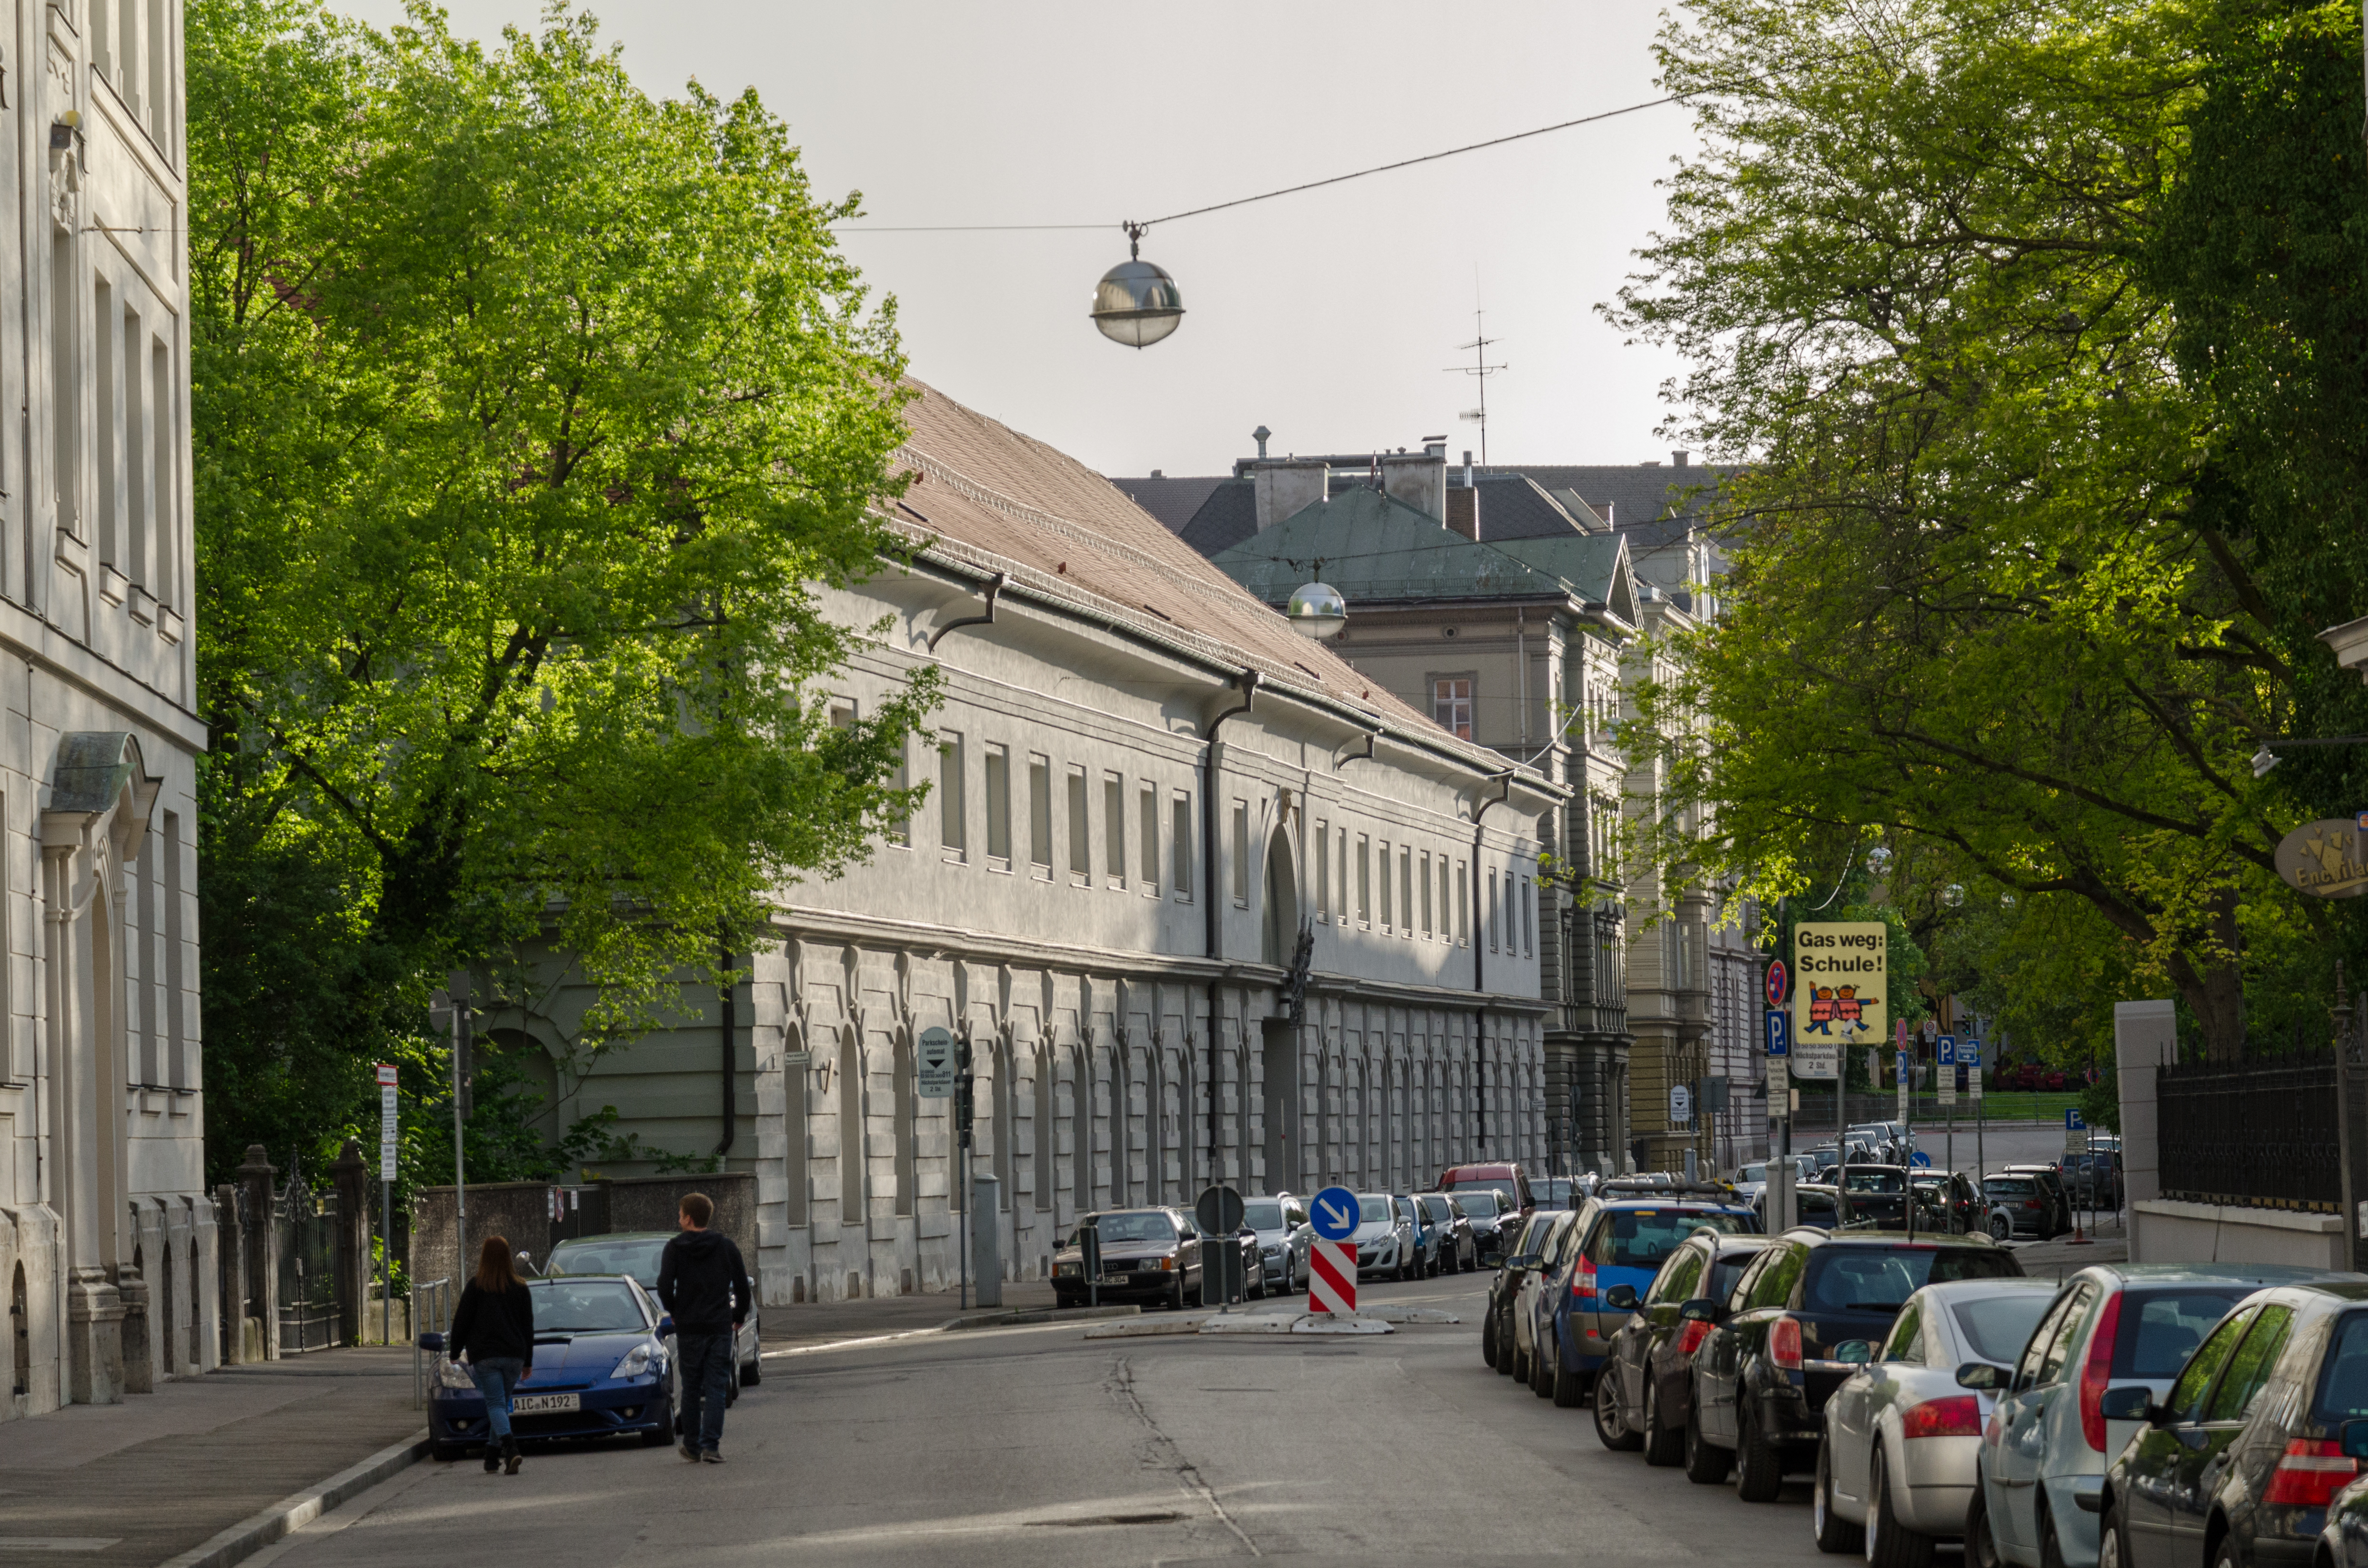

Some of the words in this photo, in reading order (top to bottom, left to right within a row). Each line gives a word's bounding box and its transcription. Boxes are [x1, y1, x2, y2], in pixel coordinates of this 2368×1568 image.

[1799, 931, 1835, 947] Gas
[1838, 934, 1883, 951] weg:
[1800, 955, 1882, 972] Schule!
[1771, 1016, 1782, 1049] P
[1795, 1052, 1836, 1060] Höchstparkdau
[1941, 1039, 1951, 1062] P
[514, 1398, 533, 1410] AIC
